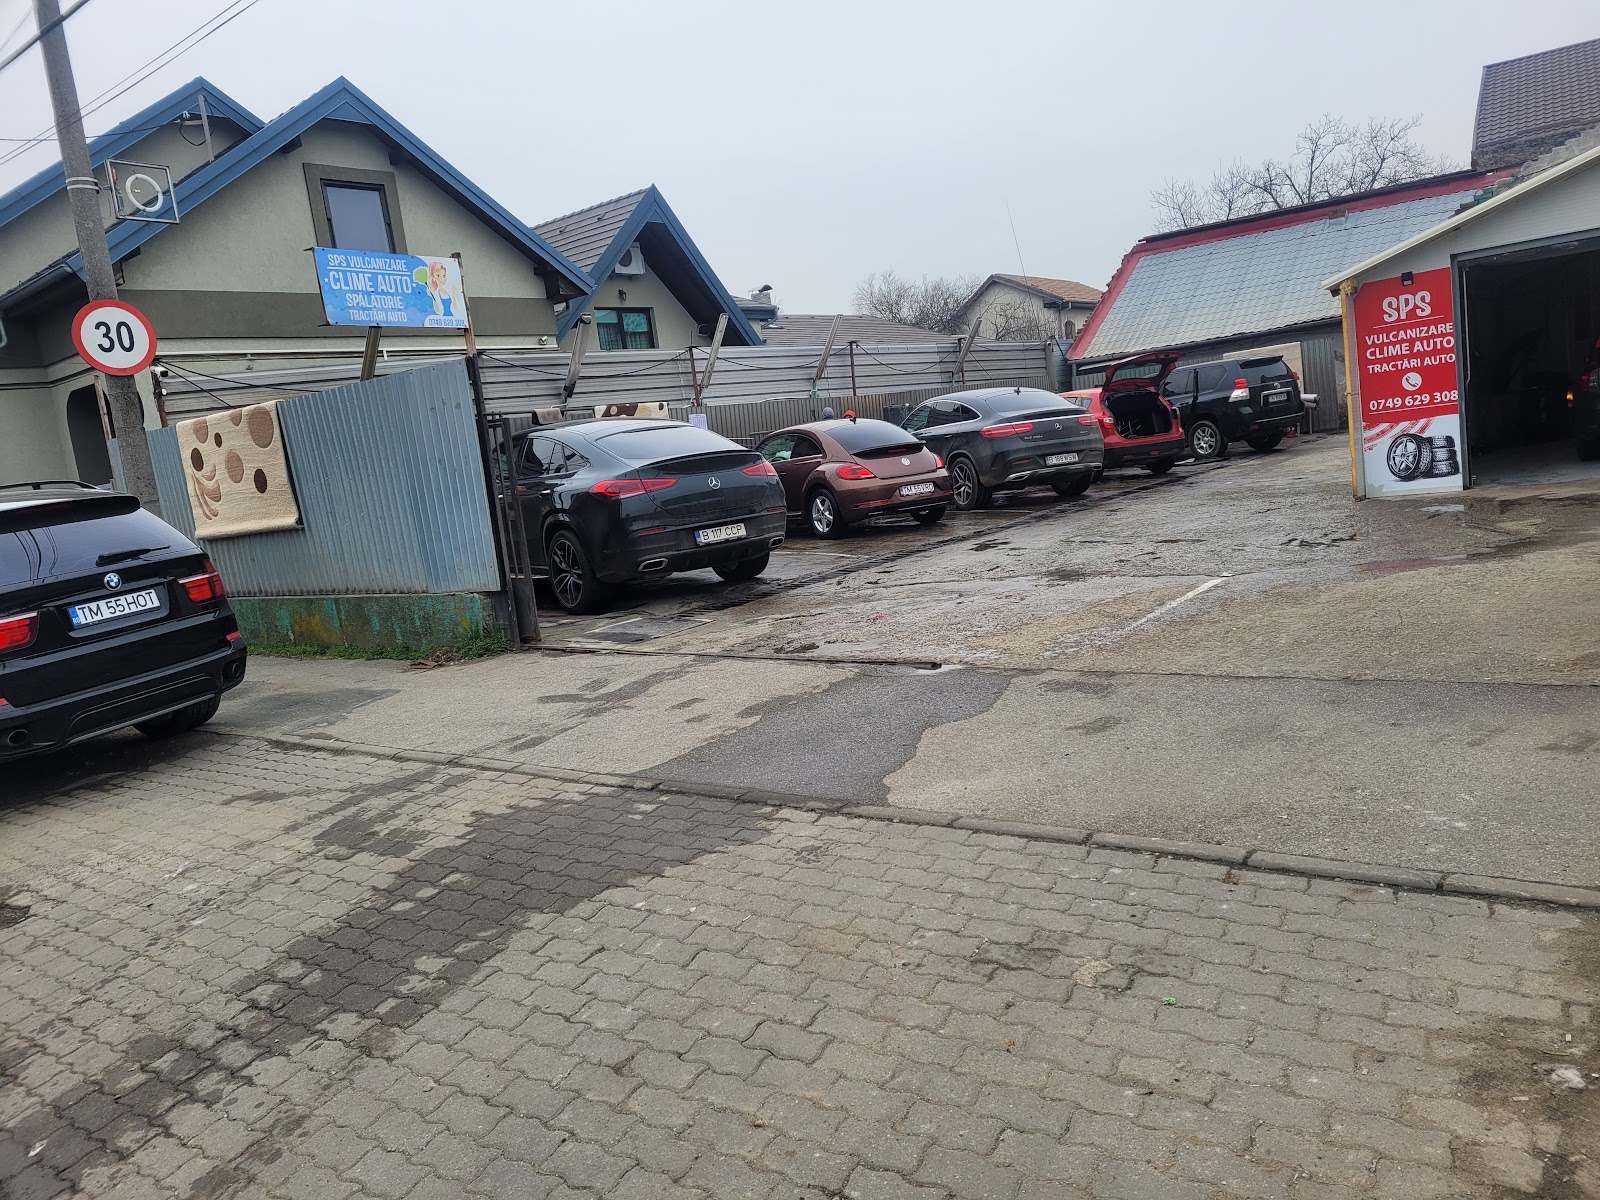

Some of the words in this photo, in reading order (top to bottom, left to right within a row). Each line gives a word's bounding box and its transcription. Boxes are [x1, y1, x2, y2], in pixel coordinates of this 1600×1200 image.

[327, 253, 347, 267] SPS
[348, 255, 408, 272] VULCANIZARE
[329, 271, 375, 292] CLIME
[378, 274, 412, 294] AUTO
[388, 311, 408, 322] AUTO
[1382, 291, 1432, 322] SPS
[94, 321, 135, 353] 30
[1365, 322, 1454, 345] VULCANIZARE
[1366, 342, 1410, 360] CLIME
[1413, 336, 1455, 353] AUTO
[1367, 358, 1421, 374] TRACTĂRI
[1423, 353, 1456, 366] AUTO
[1369, 397, 1402, 411] 0749
[1405, 393, 1431, 407] 629
[1433, 390, 1459, 402] 308
[701, 530, 710, 541] B
[711, 528, 722, 539] 117
[724, 524, 742, 536] CCP
[77, 603, 104, 622] TM
[105, 598, 126, 615] 55
[124, 591, 155, 611] HOT
